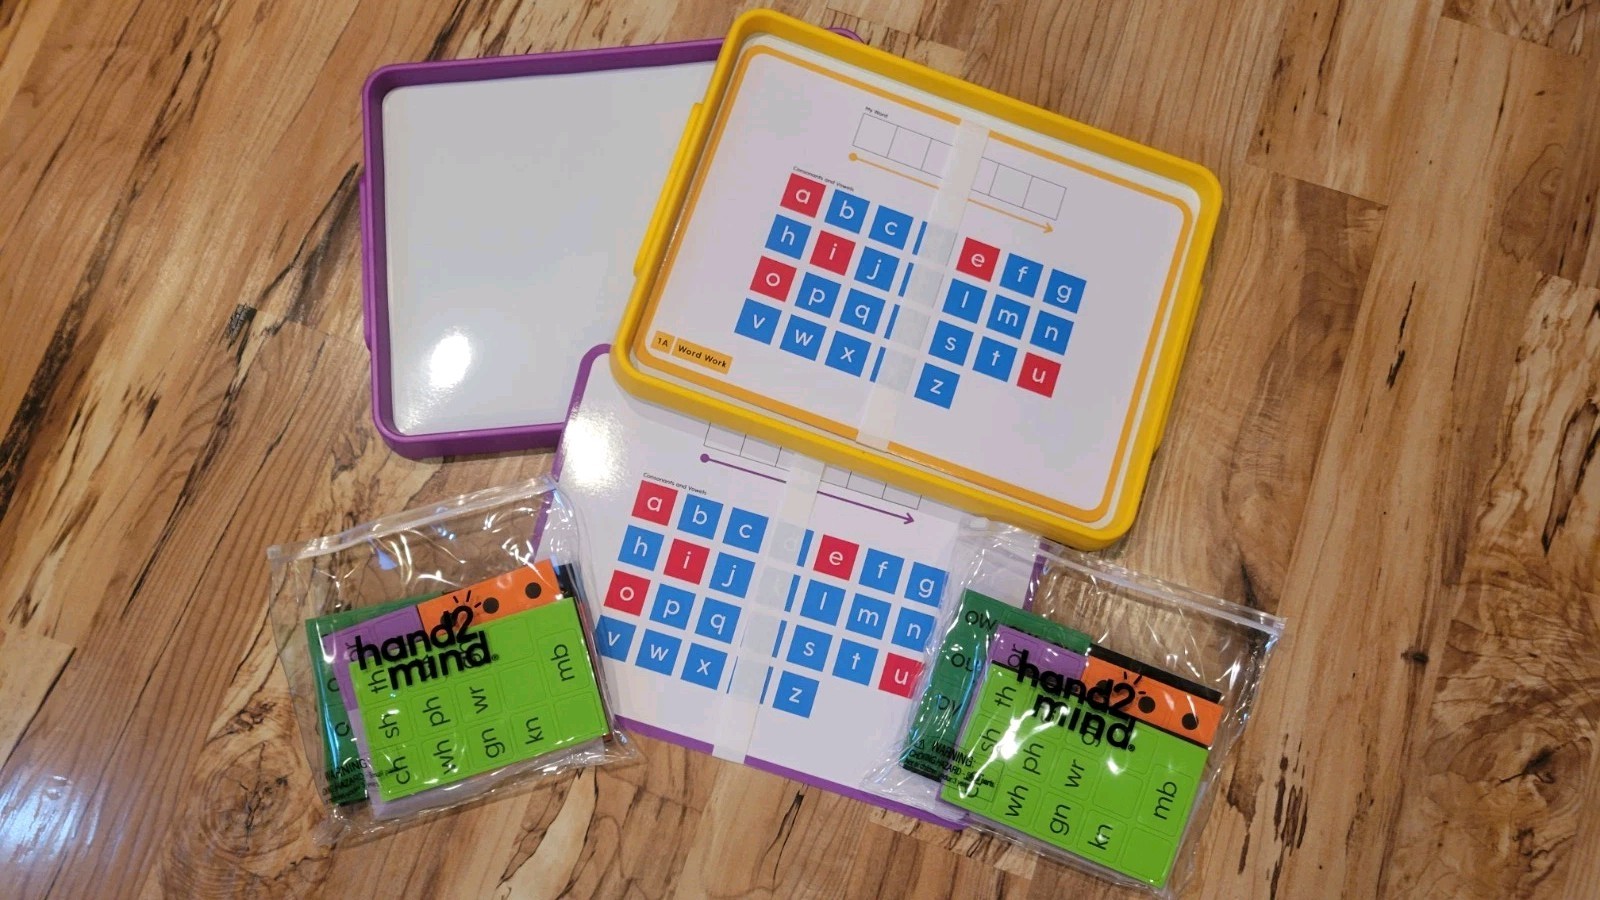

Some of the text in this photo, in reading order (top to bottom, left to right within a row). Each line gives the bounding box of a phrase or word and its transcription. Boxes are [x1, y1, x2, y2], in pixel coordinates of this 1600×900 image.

[792, 165, 824, 181] Consonants
[795, 188, 1073, 304] a b c e f g
[780, 225, 795, 246] h
[866, 258, 882, 281] j
[997, 308, 1019, 327] m
[1044, 325, 1059, 342] n
[657, 337, 669, 348] 1A
[765, 272, 1047, 384] o p q s t u
[678, 344, 727, 368] Word Work
[753, 313, 944, 395] v w x z
[643, 472, 707, 496] Consonants and Vowels
[646, 496, 663, 513] a
[692, 504, 708, 525] b
[738, 524, 753, 539] c
[828, 551, 844, 566] e
[877, 560, 889, 579] f
[918, 578, 935, 599] g
[633, 535, 648, 557] h
[721, 563, 737, 588] j
[856, 607, 879, 627] m
[906, 622, 922, 640] n
[619, 586, 909, 686] o p q s t u
[965, 610, 998, 632] ow
[355, 605, 478, 671] hand2
[550, 644, 575, 682] mb
[608, 631, 803, 704] v w x z
[368, 668, 388, 694] th
[1017, 648, 1136, 719] hand2
[422, 696, 451, 727] ph
[469, 686, 488, 714] wr
[994, 686, 1017, 708] th
[378, 709, 400, 738] sh
[525, 717, 544, 745] kn
[481, 728, 506, 758] gn
[981, 728, 1001, 752] sh
[388, 756, 411, 784] ch
[1022, 743, 1044, 775] ph
[1064, 759, 1085, 787] wr
[1005, 785, 1029, 817] wh
[1153, 781, 1177, 820] mb
[1050, 804, 1071, 836] gn
[1088, 824, 1113, 850] kn
